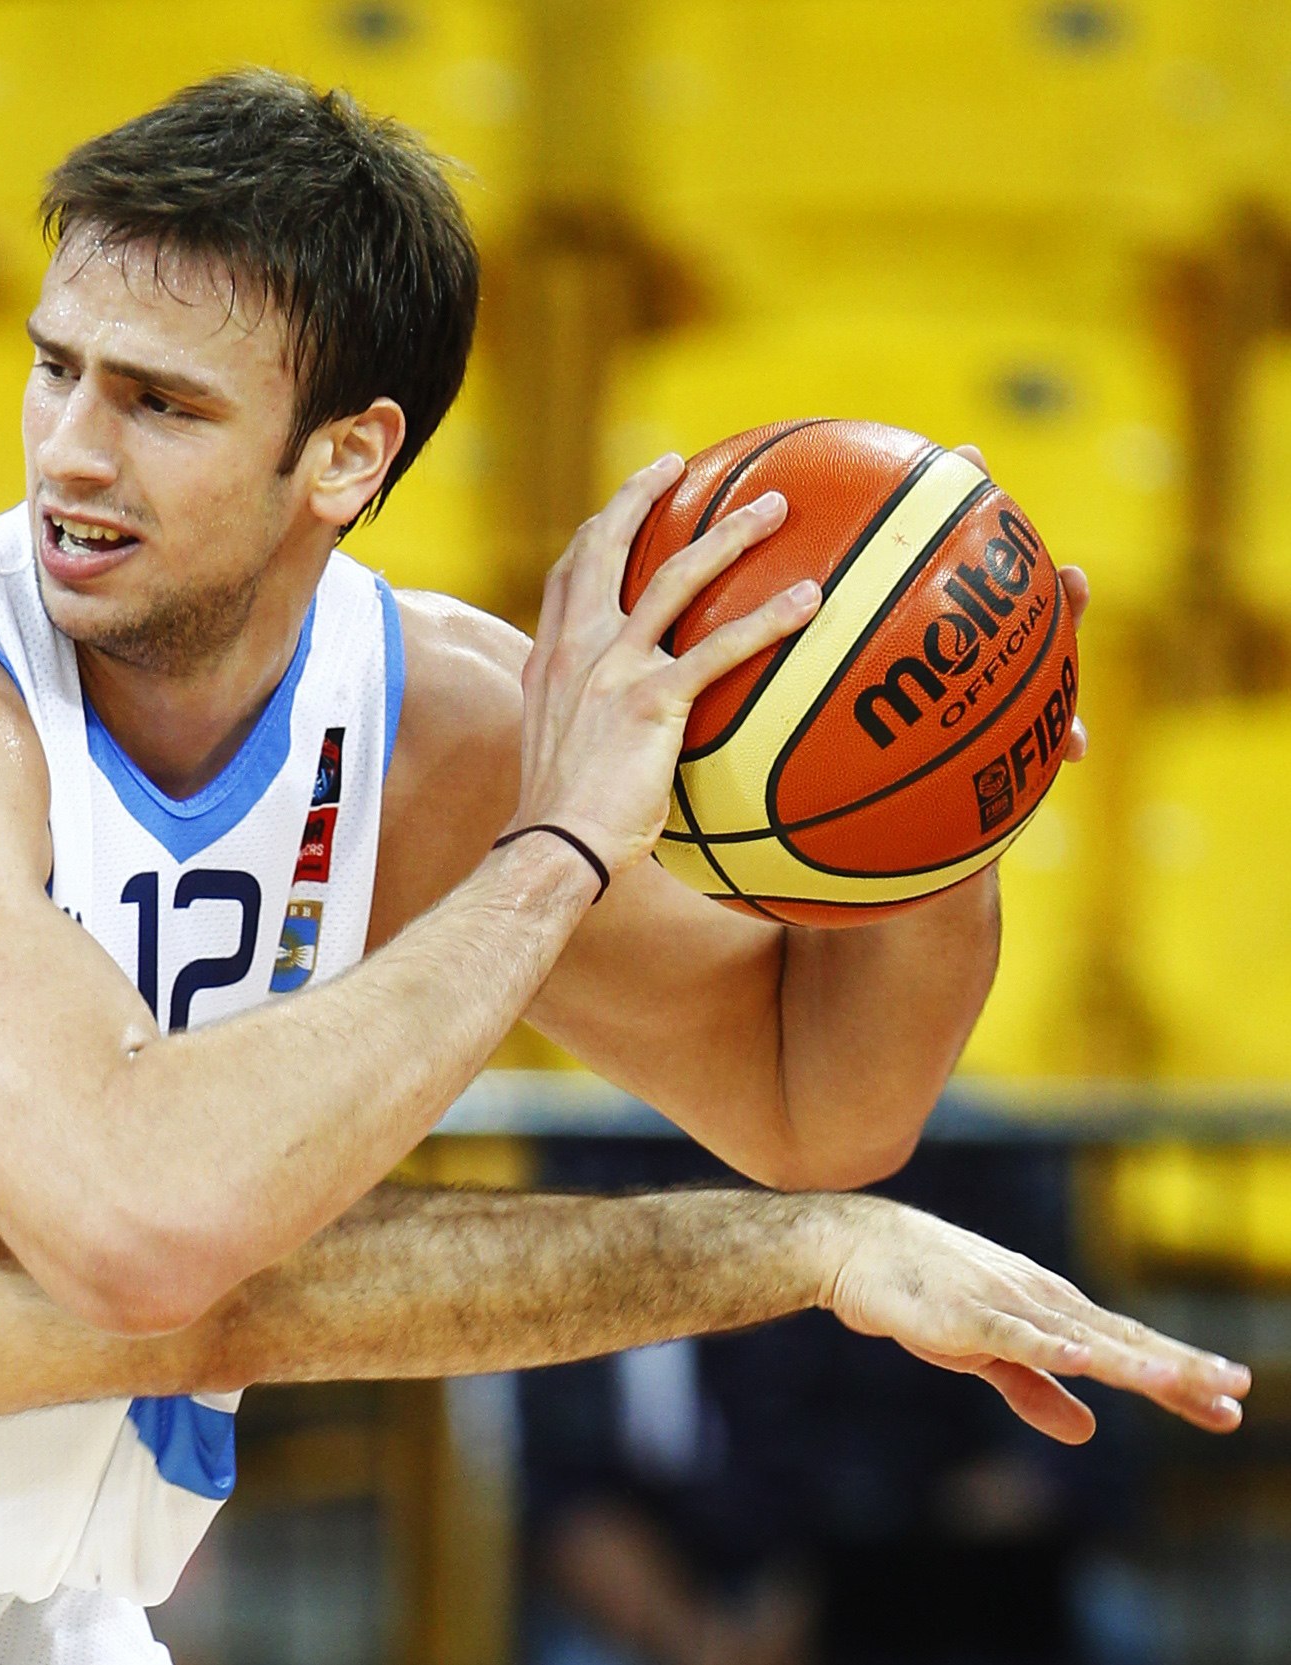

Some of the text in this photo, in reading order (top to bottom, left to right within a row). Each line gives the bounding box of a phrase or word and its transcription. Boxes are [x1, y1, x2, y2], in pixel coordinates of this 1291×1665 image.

[853, 509, 1039, 750] molten
[940, 595, 1048, 728] OFFICIAL
[1009, 656, 1077, 794] FIBA
[120, 868, 262, 1035] 12
